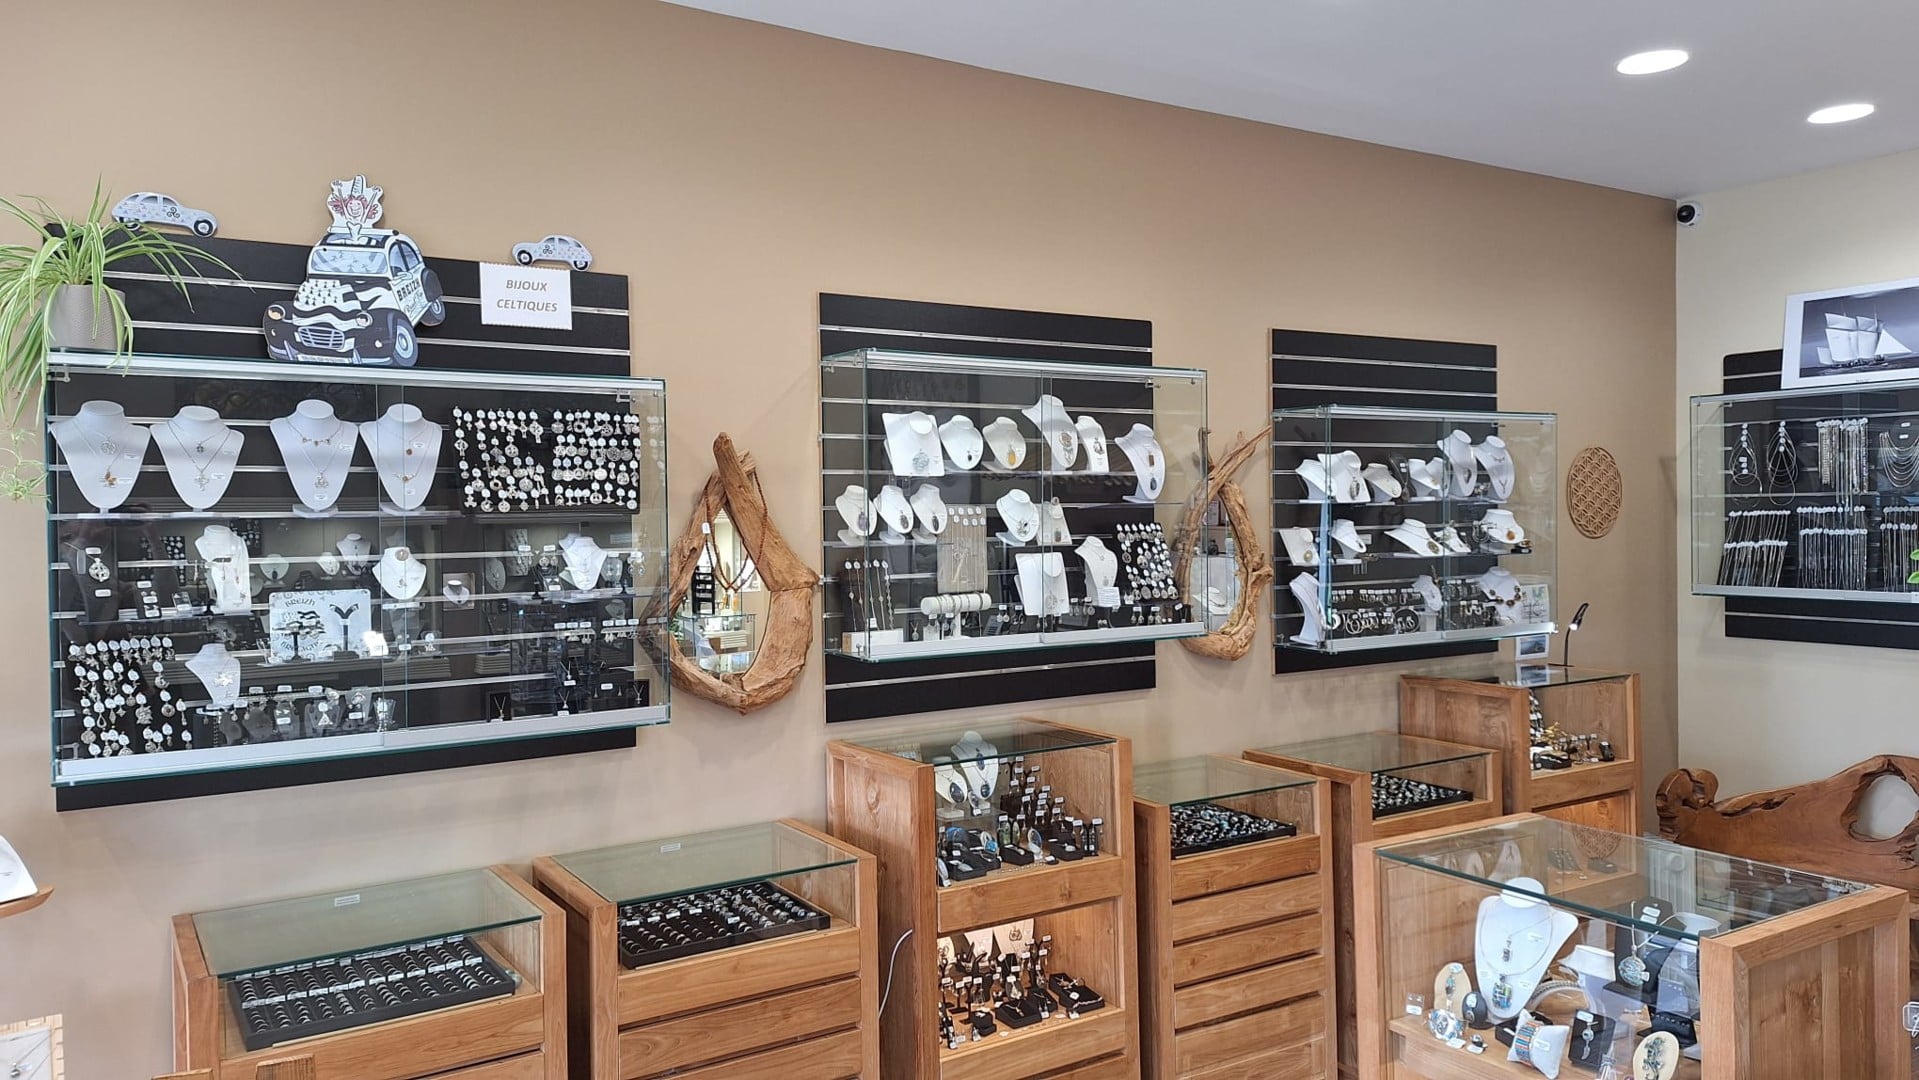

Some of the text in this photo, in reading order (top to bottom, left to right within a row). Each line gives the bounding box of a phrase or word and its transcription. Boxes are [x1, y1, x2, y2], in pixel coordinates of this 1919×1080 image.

[396, 277, 421, 301] BREIZH
[506, 279, 548, 291] BIJOUX
[496, 299, 558, 312] CELTIQUES
